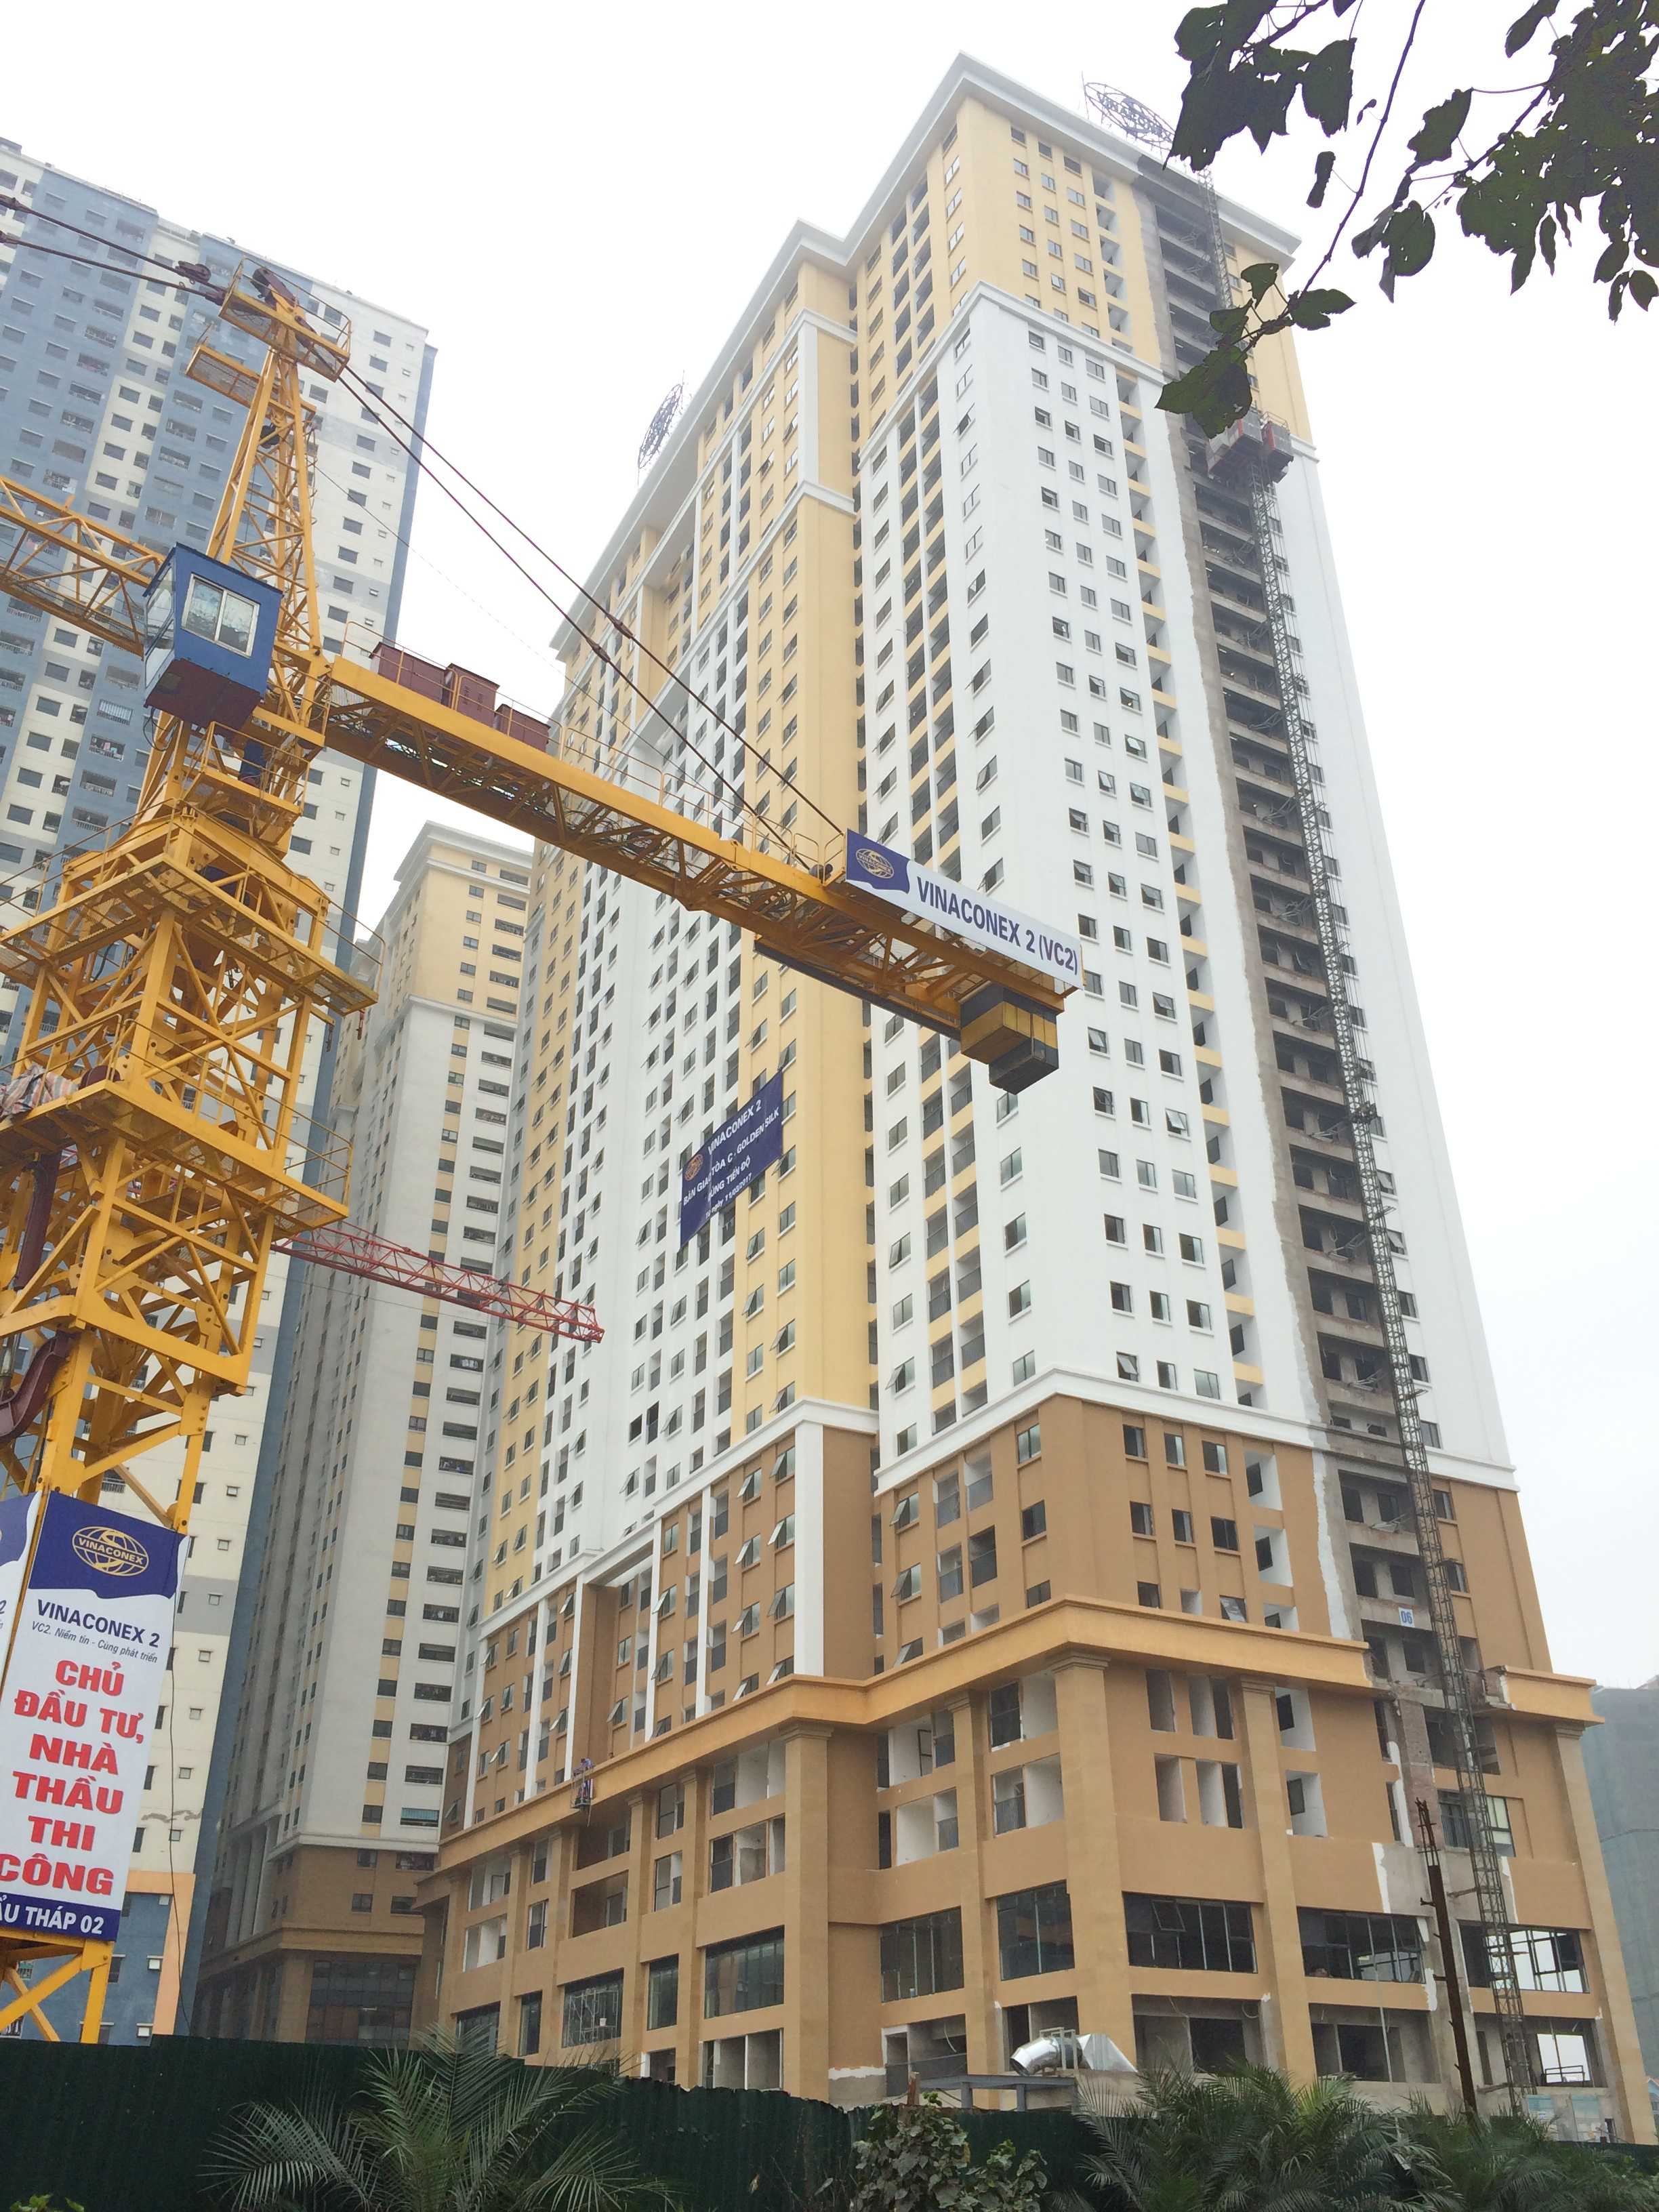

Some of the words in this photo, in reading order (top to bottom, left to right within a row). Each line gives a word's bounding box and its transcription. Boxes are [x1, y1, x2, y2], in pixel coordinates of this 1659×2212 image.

[917, 876, 1021, 947] VINACONEX
[1026, 930, 1035, 954] 2
[1039, 935, 1078, 975] (VC2)
[708, 1103, 754, 1155] VINACONEX
[755, 1099, 762, 1112] 2
[683, 1187, 696, 1206] BÀN
[712, 1160, 726, 1176] TÒA
[727, 1153, 733, 1163] C
[737, 1125, 764, 1153] GOLDEN
[764, 1107, 779, 1128] SILK
[741, 1154, 751, 1172] ĐỘ
[78, 1536, 144, 1565] VINACONEX
[38, 1599, 145, 1644] VINACONEX
[148, 1633, 160, 1647] 2
[1401, 1610, 1412, 1624] 06
[32, 1620, 52, 1635] VC2.
[79, 1635, 90, 1645] tin
[119, 1646, 138, 1658] phát
[56, 1660, 124, 1697] CHỦ
[14, 1689, 87, 1727] ĐẦU
[100, 1707, 144, 1744] TƯ,
[29, 1734, 119, 1776] NHÀ
[12, 1771, 124, 1815] THẦU
[28, 1816, 96, 1851] THI
[0, 1853, 114, 1896] CÔNG
[25, 1905, 77, 1930] THÁP
[80, 1915, 104, 1935] 02
